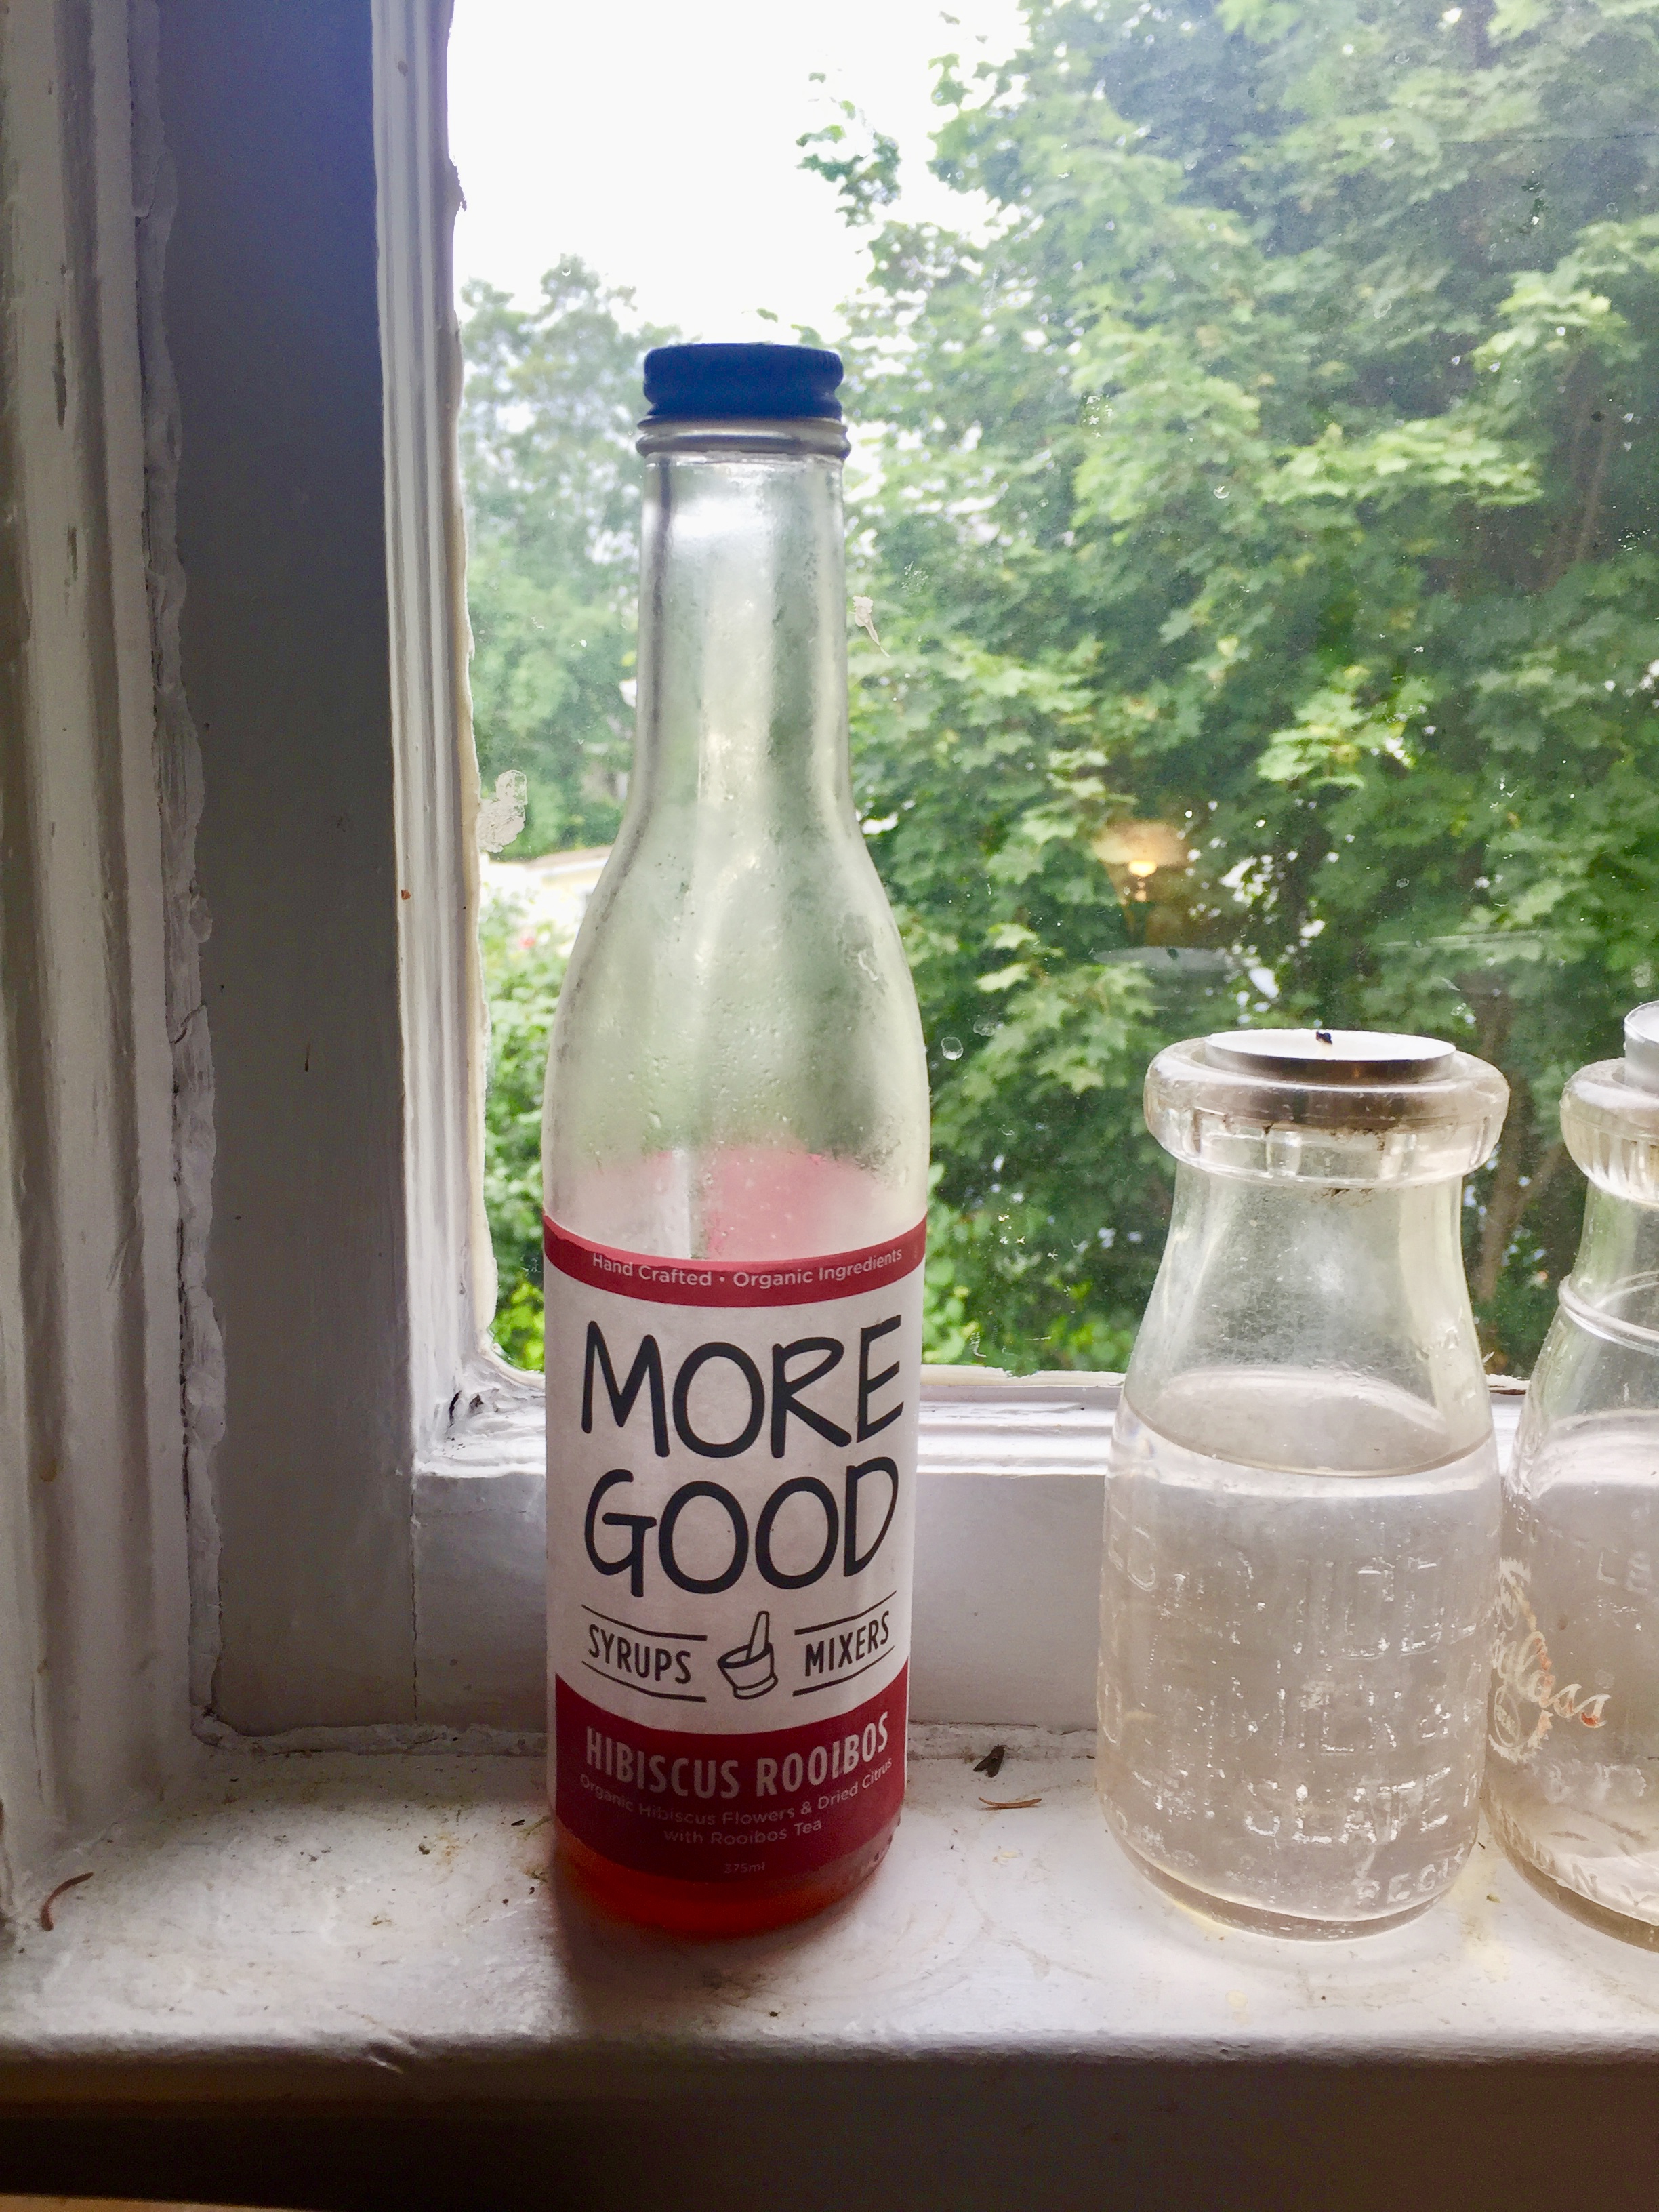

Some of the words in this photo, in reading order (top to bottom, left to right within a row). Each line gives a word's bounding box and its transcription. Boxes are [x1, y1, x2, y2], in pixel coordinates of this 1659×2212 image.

[592, 1252, 633, 1277] Hand
[638, 1265, 712, 1286] Crafted
[733, 1269, 813, 1289] Organic
[818, 1248, 903, 1283] Ingredients
[581, 1315, 904, 1458] MORE
[583, 1456, 899, 1597] GOOD
[588, 1624, 691, 1684] SYRUPS
[805, 1610, 890, 1677] MIXERS
[579, 1774, 634, 1814] Organic
[638, 1803, 716, 1826] Hibiscus
[722, 1804, 795, 1826] Flowers
[800, 1801, 812, 1815] &
[818, 1784, 858, 1811] Dried
[861, 1758, 893, 1790] Citrus
[586, 1727, 739, 1799] HIBISCUS
[756, 1711, 889, 1797] ROOIBOS
[663, 1828, 703, 1845] with
[710, 1828, 788, 1845] Rooibos
[794, 1819, 823, 1836] Tea
